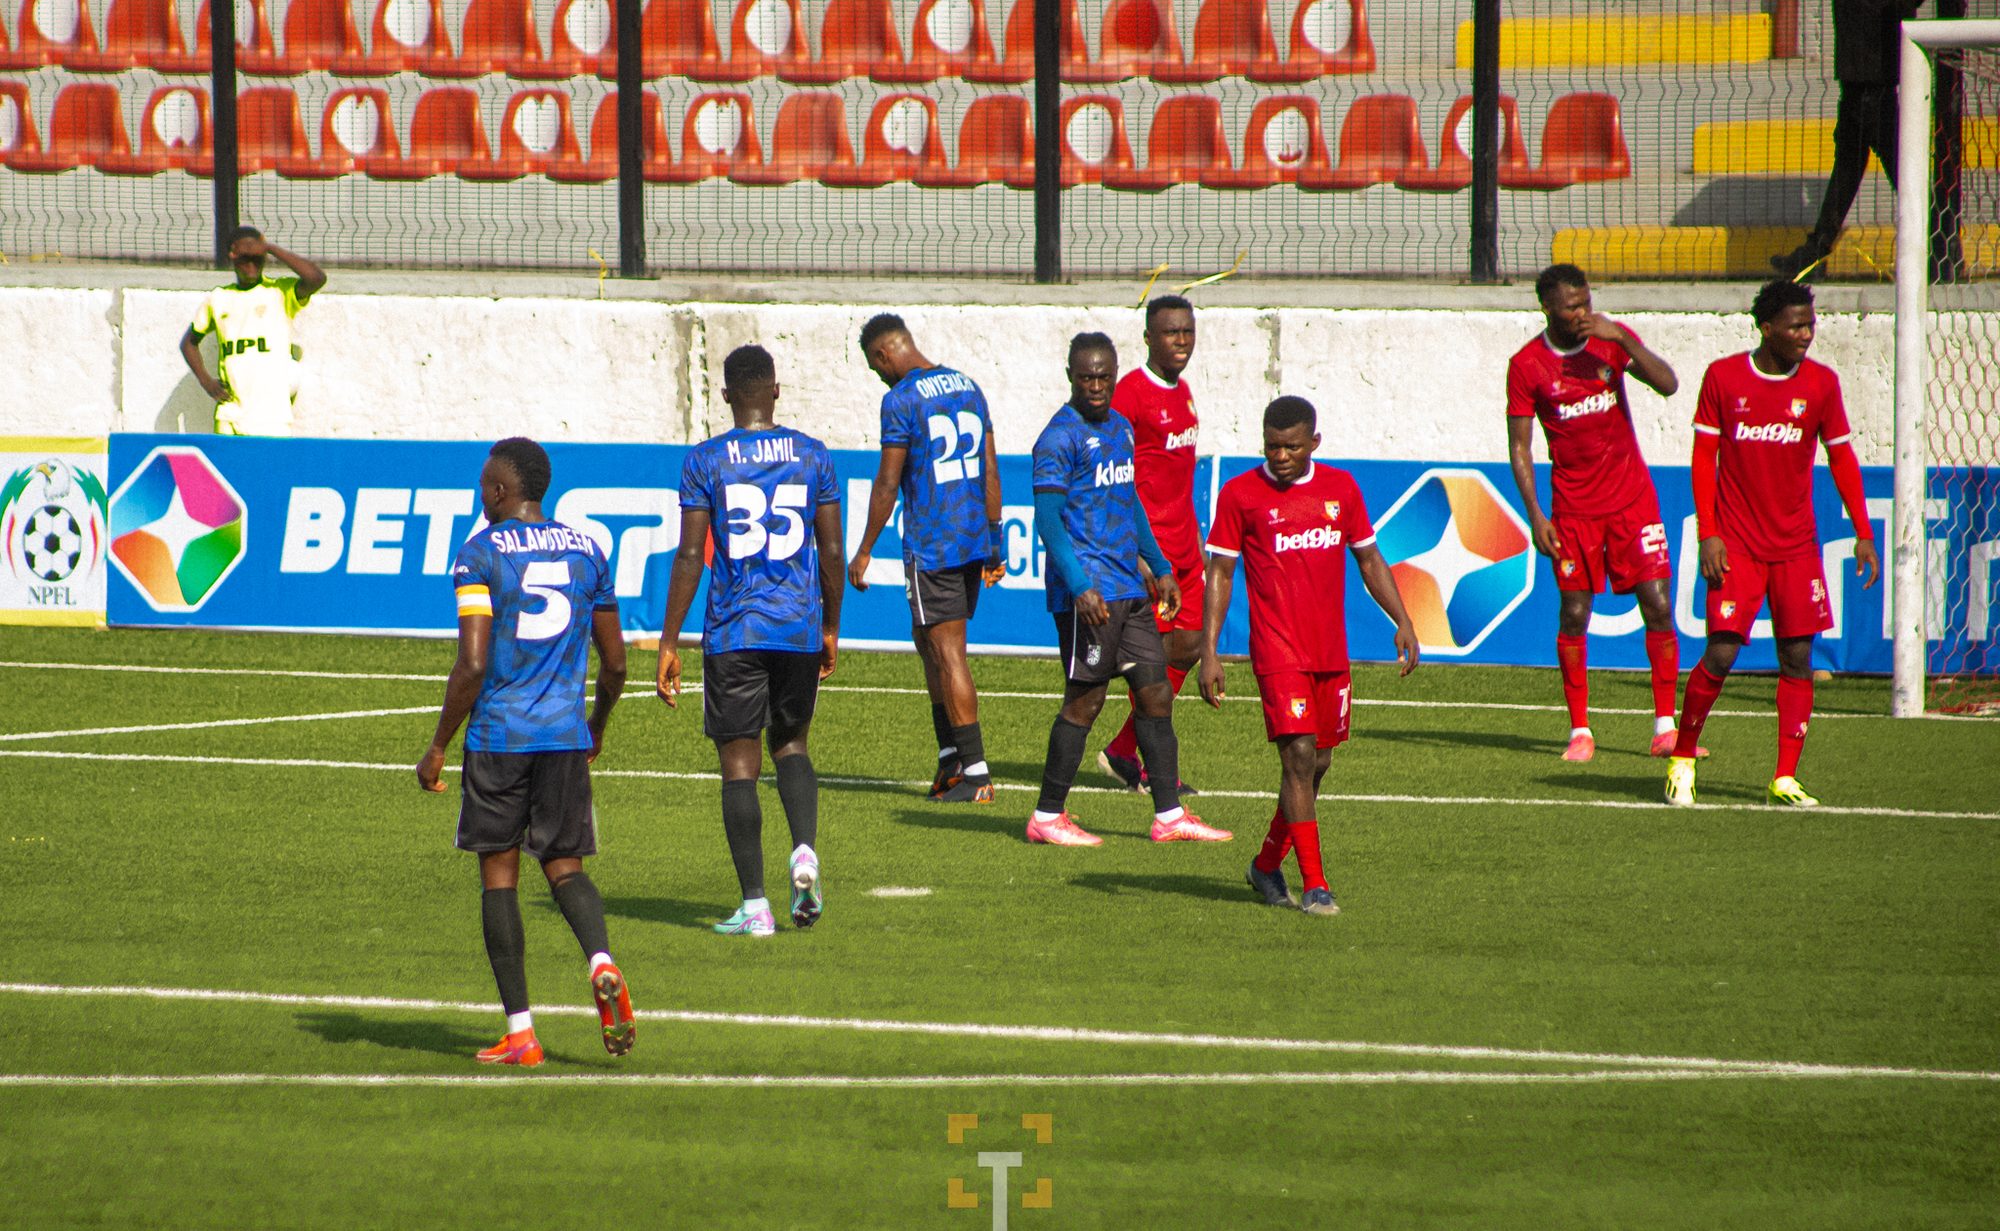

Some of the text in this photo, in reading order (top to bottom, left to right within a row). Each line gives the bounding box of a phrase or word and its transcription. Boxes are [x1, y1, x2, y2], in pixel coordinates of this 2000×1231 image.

[928, 411, 983, 484] 22
[1735, 422, 1803, 444] bet9ja
[727, 437, 800, 464] M. JAMIL
[725, 483, 808, 561] 35
[1275, 524, 1342, 553] bet9ja
[28, 586, 77, 605] NPFL
[515, 561, 571, 640] 5
